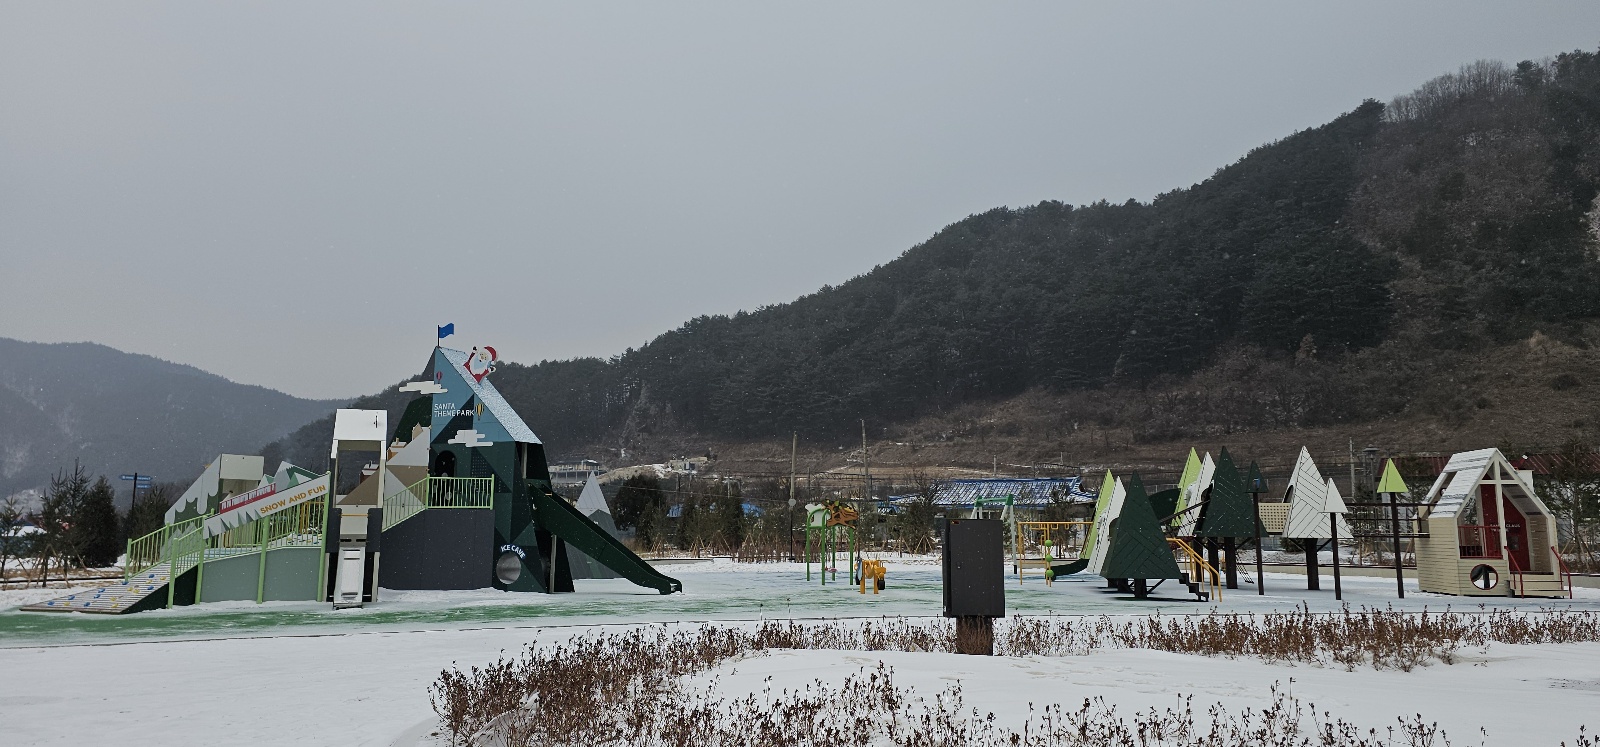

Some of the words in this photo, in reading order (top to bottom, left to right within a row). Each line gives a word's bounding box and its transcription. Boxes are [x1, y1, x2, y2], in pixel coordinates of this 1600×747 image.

[456, 409, 475, 417] PARK
[260, 499, 287, 515] SNOW
[288, 491, 307, 504] AND
[307, 484, 326, 497] FUN
[500, 544, 511, 552] ICE
[511, 545, 526, 559] CAVE
